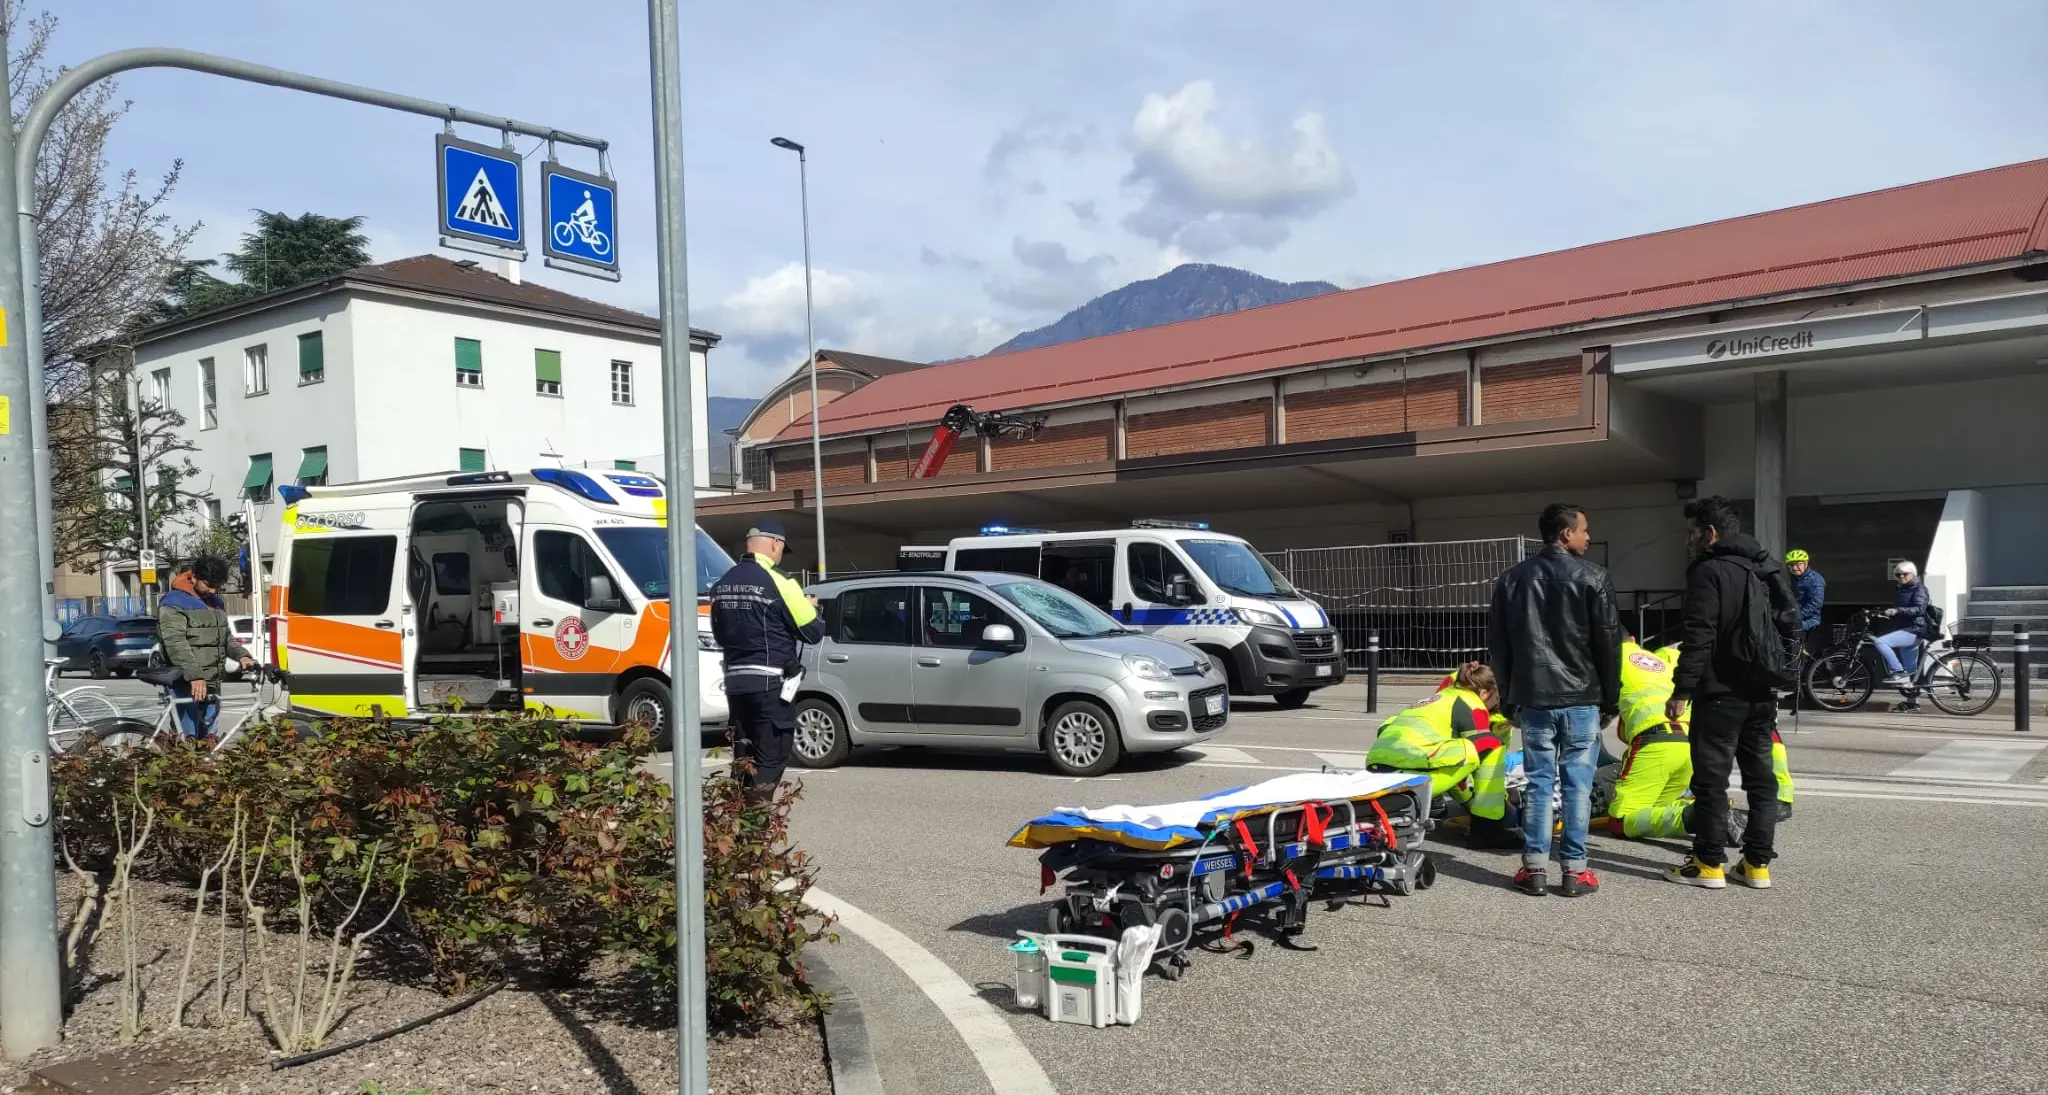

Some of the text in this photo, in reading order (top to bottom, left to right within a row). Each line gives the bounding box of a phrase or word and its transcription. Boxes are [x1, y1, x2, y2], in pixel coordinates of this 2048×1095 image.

[1729, 331, 1814, 356] UniCredit
[295, 512, 366, 529] OCCORSO
[1203, 857, 1233, 870] WEISSES
